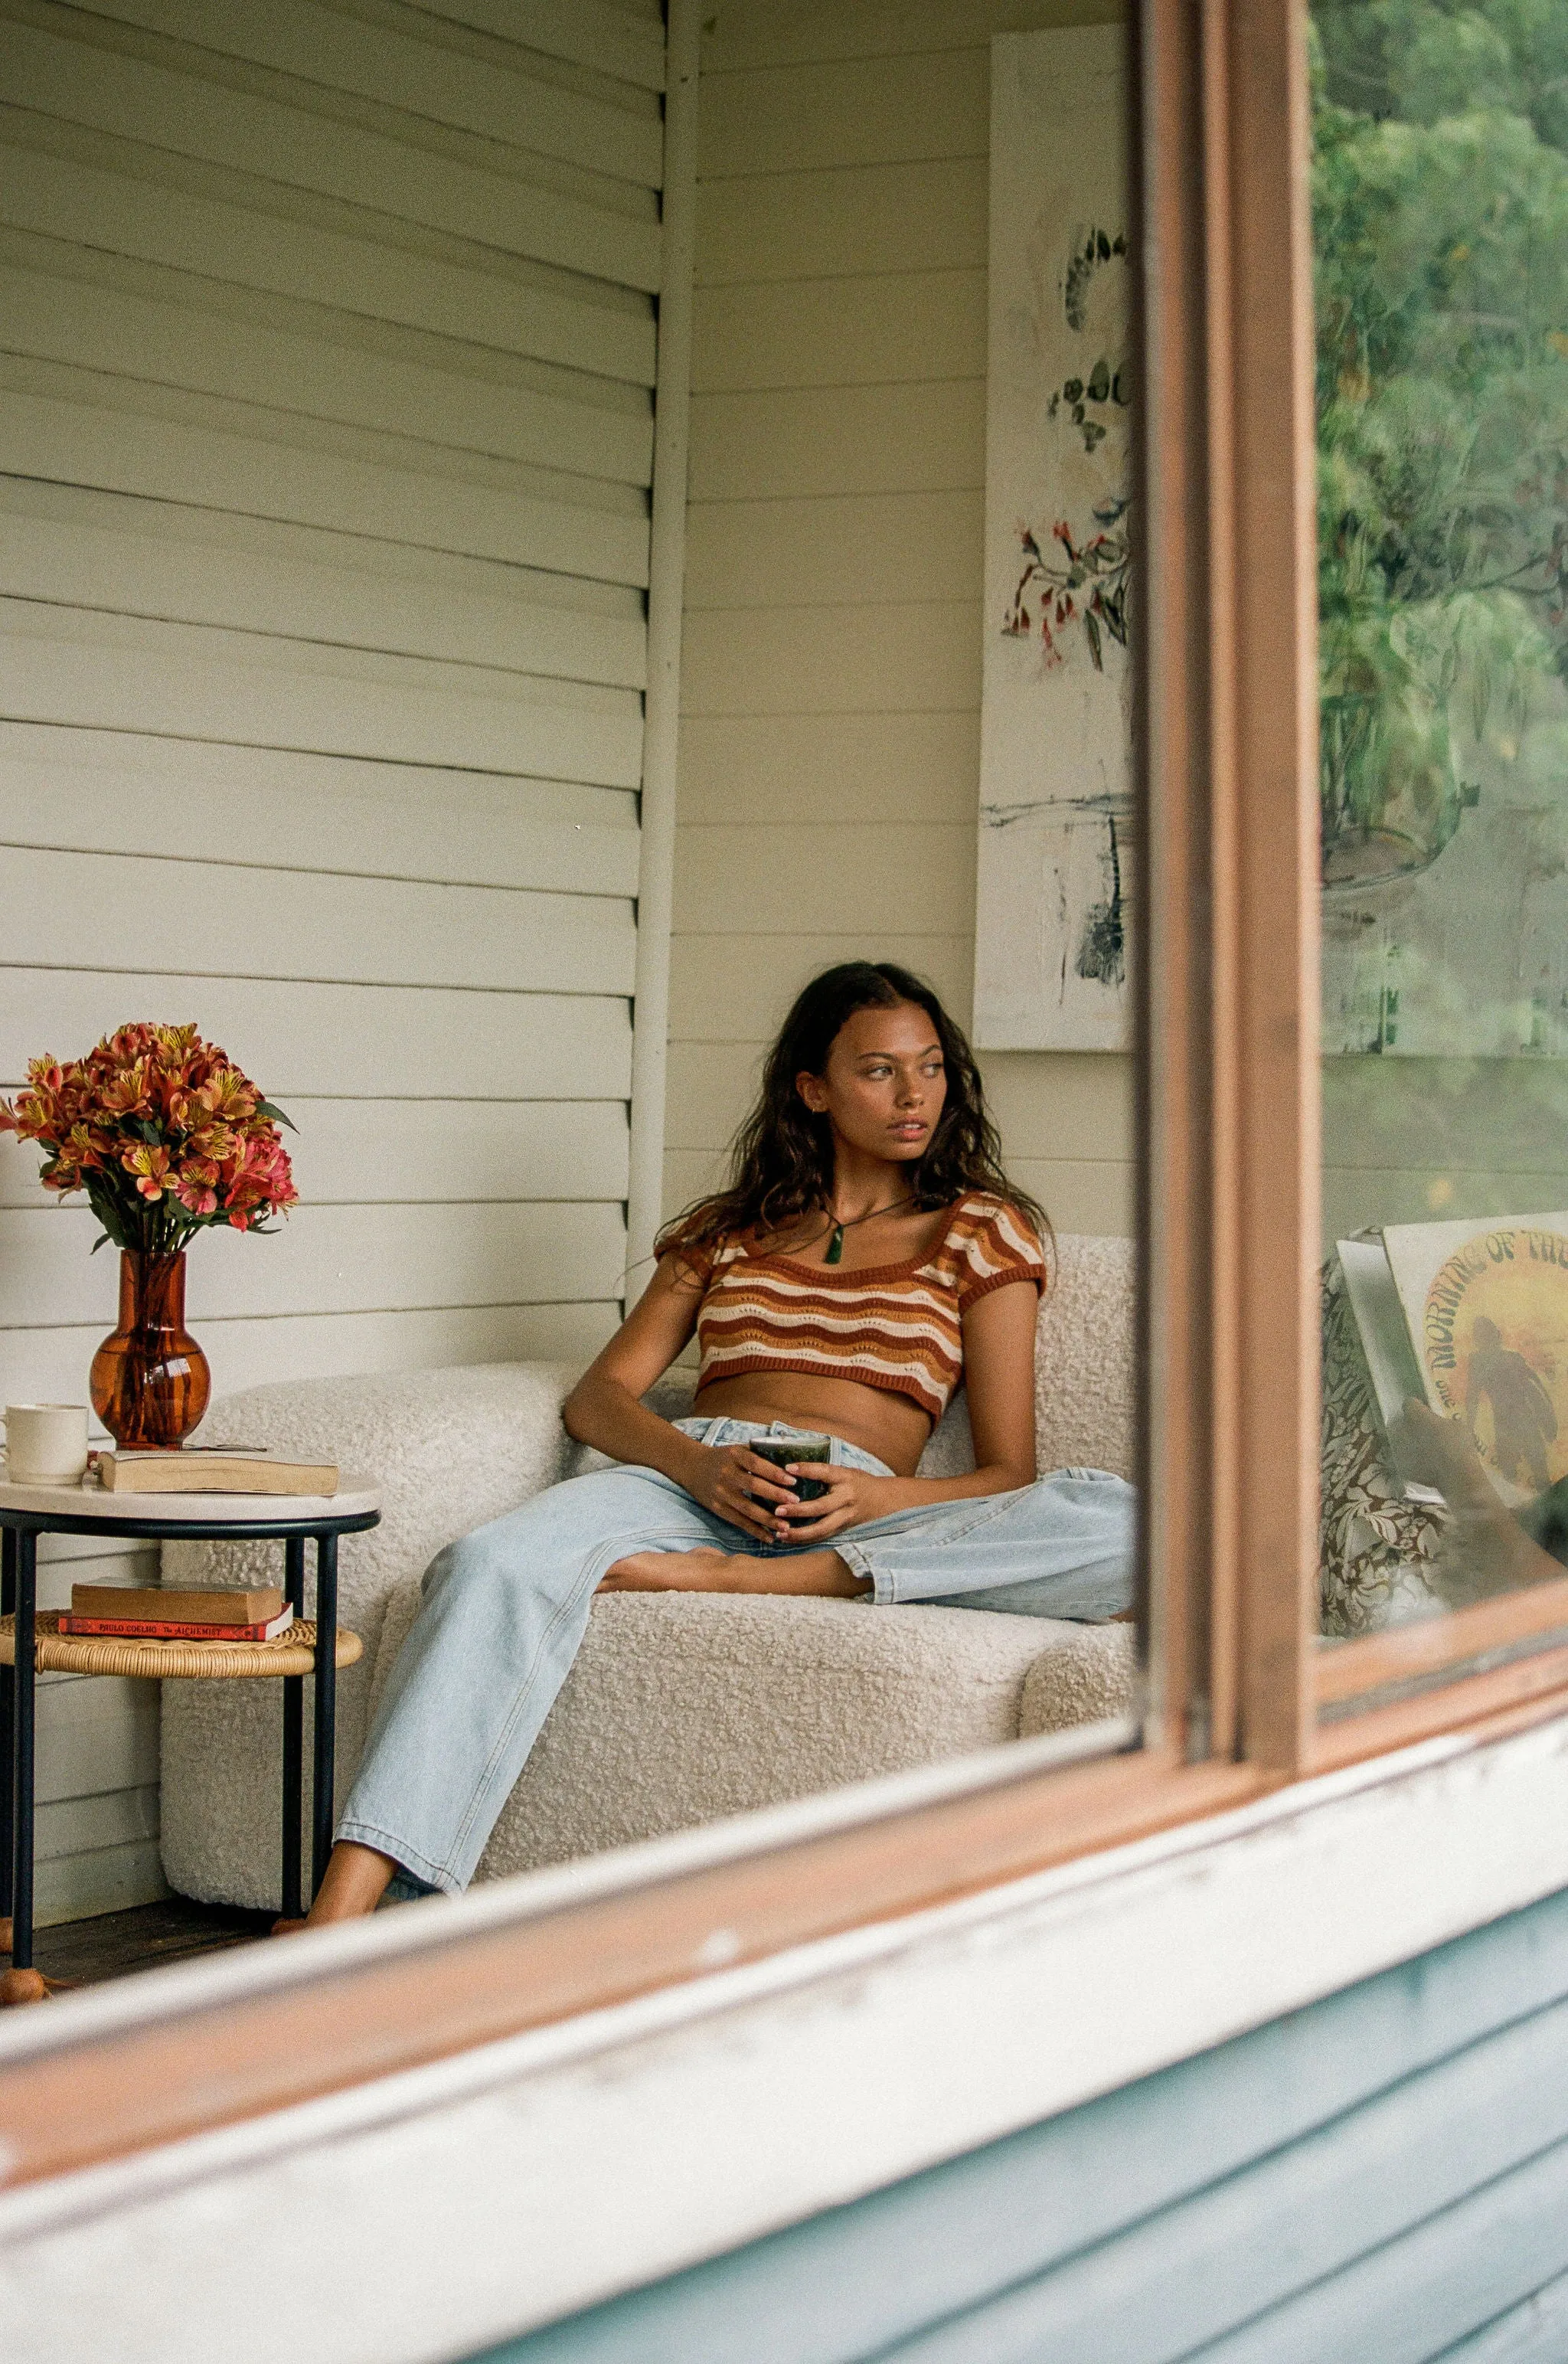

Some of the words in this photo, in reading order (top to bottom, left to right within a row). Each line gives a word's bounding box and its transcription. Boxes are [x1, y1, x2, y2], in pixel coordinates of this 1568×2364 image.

[1426, 1244, 1488, 1370] MORNING
[1485, 1231, 1516, 1264] OF
[99, 1623, 124, 1633] PAULO
[126, 1625, 157, 1633] COELHO
